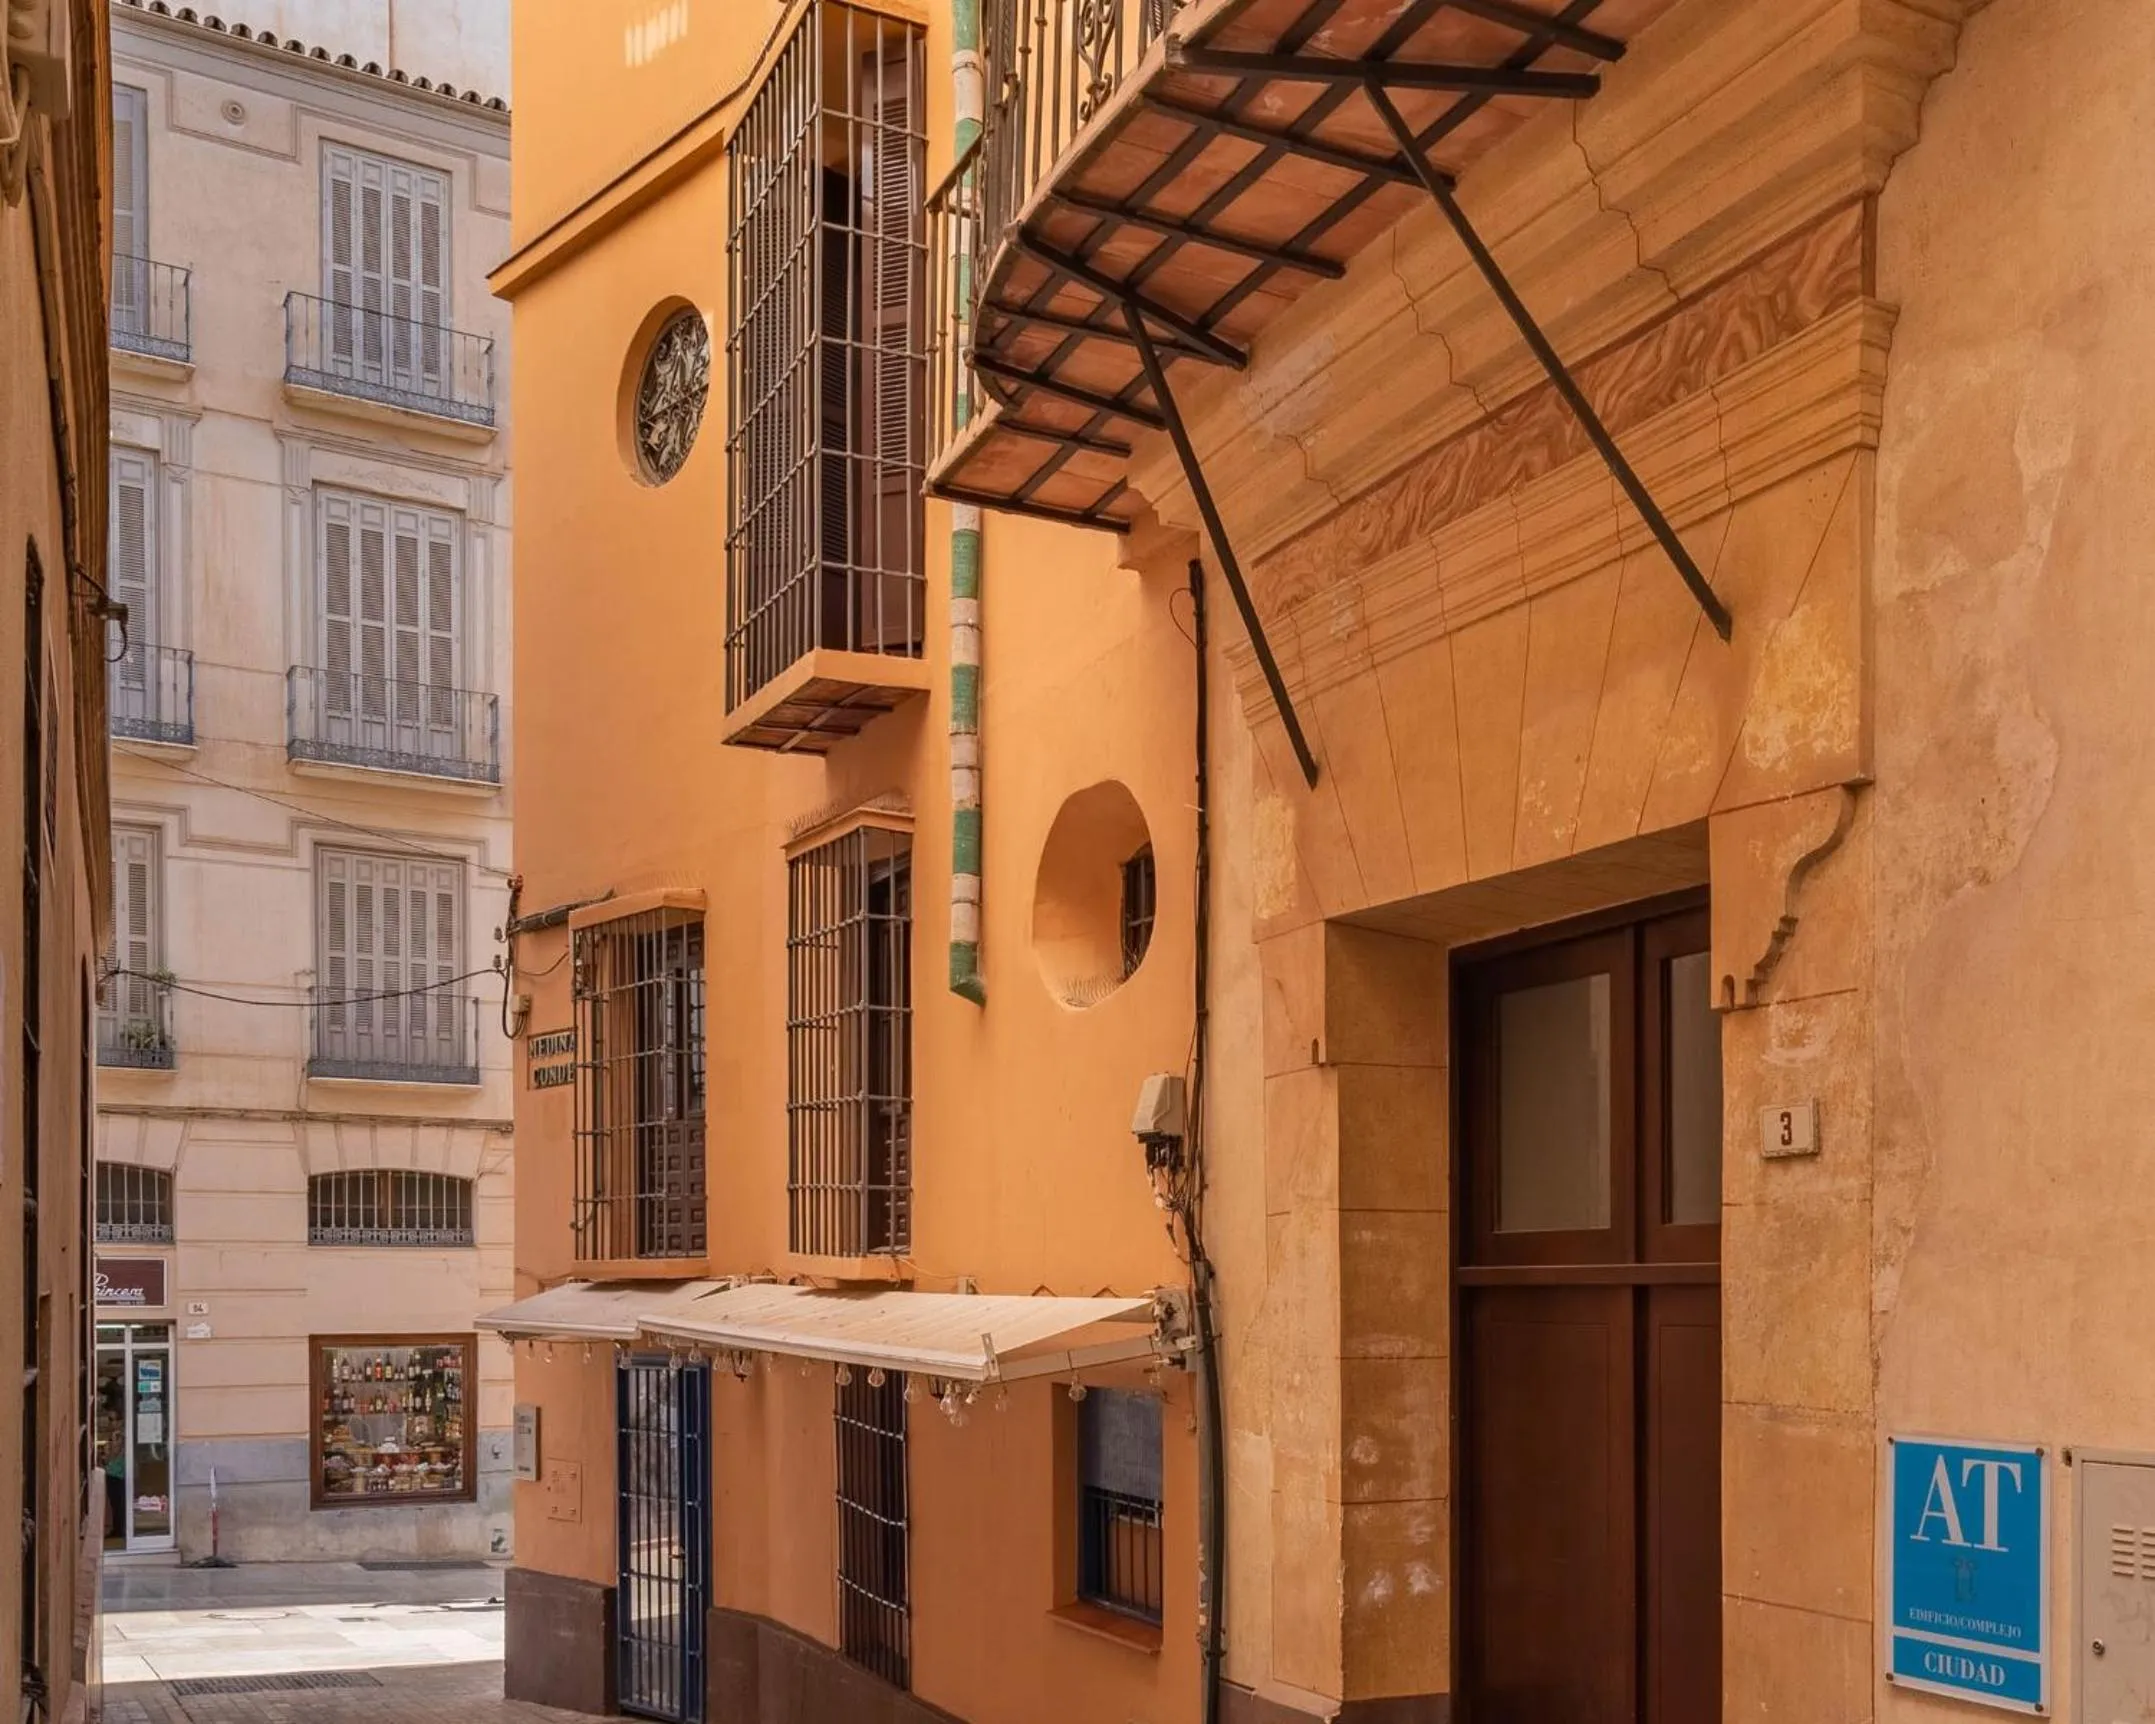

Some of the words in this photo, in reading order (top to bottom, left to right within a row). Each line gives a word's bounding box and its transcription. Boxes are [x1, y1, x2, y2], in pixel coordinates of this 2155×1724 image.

[528, 1032, 575, 1057] MEDINA
[532, 1062, 575, 1087] CONDE
[1780, 1111, 1792, 1146] 3
[1910, 1454, 2022, 1552] AT
[1909, 1607, 2022, 1638] EDIFICIO/COMPLEJO
[1924, 1650, 2006, 1687] CIUDAD
